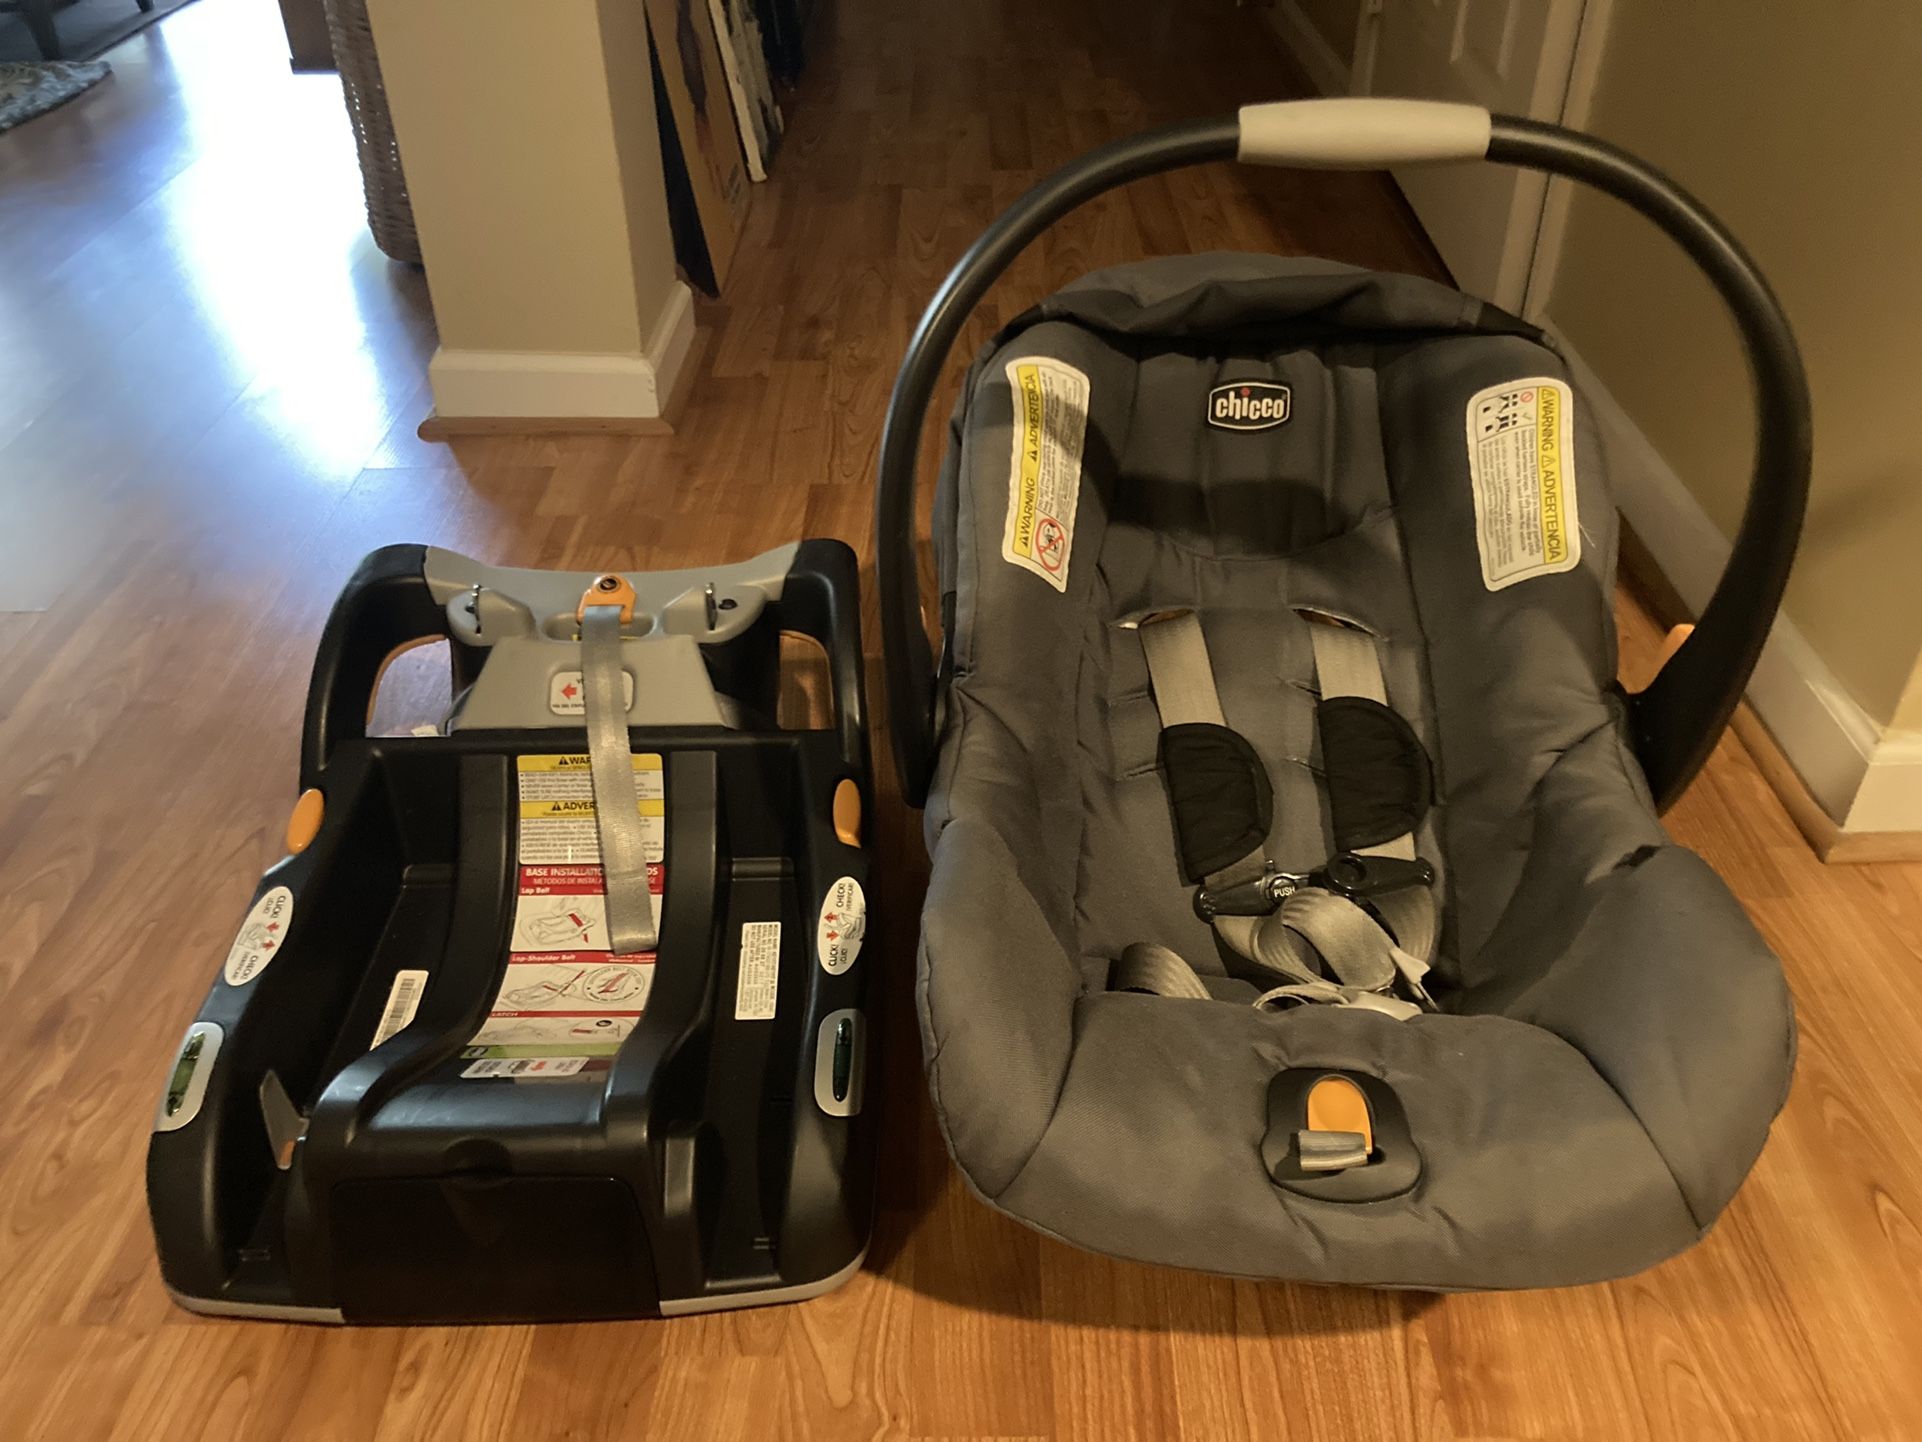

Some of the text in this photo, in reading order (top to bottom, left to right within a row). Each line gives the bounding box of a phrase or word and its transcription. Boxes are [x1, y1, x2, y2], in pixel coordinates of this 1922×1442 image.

[1215, 387, 1285, 420] chicco
[1021, 374, 1040, 535] WARNING ADVERTENCIA
[1541, 399, 1563, 560] WARNING ADVERTENCIA
[526, 867, 603, 876] BASE INSTALLATIO
[521, 887, 535, 895] Lap
[1273, 886, 1296, 898] PUSH
